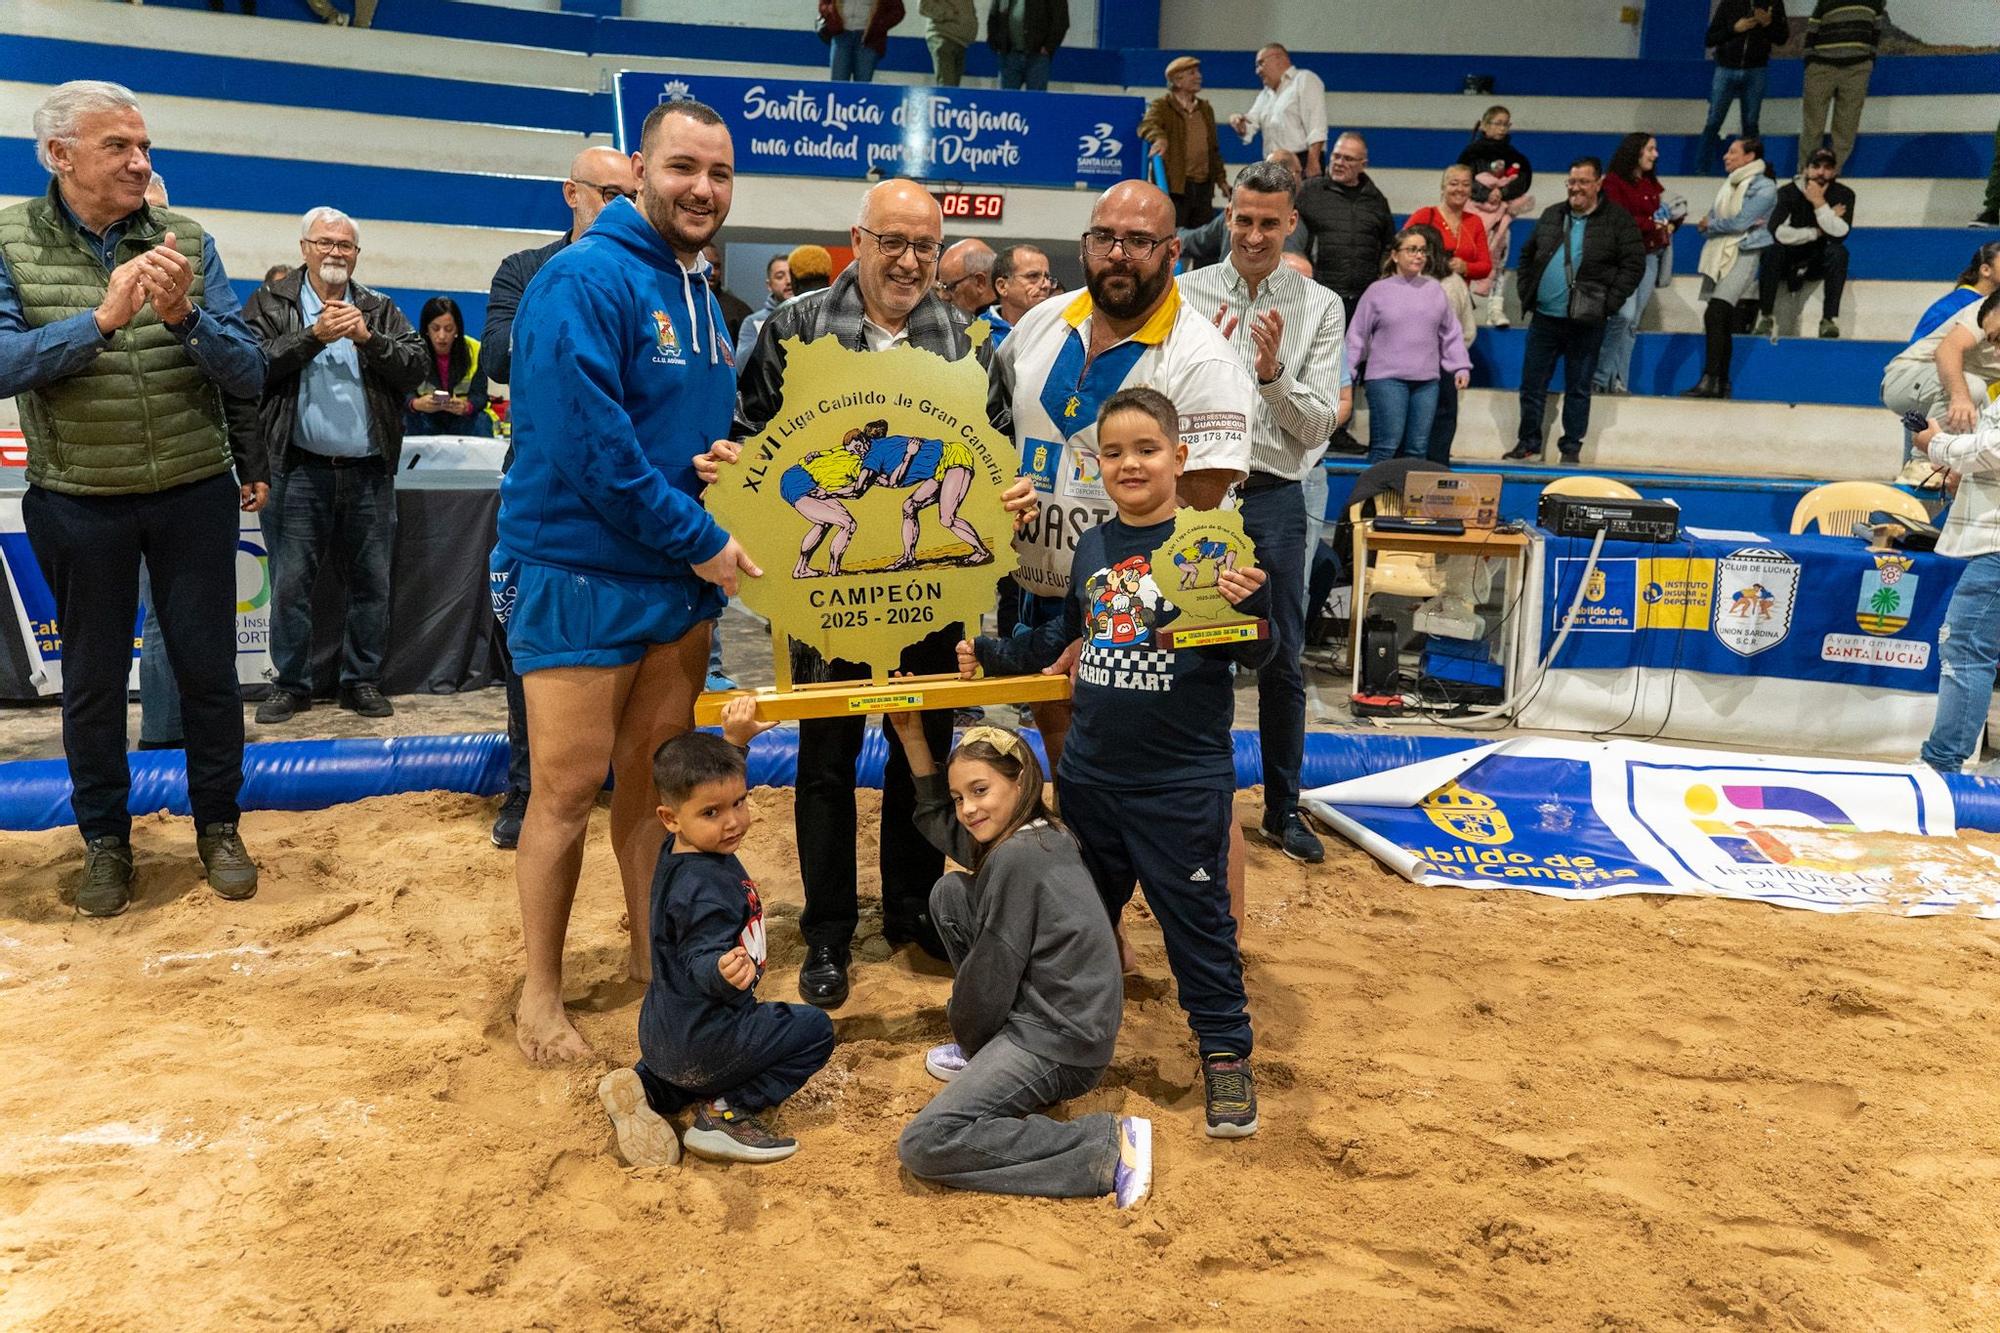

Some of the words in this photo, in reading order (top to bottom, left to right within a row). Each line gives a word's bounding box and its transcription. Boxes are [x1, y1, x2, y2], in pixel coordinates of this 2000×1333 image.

[743, 86, 822, 122] Santa
[822, 93, 885, 131] Lucía
[891, 98, 922, 128] de
[929, 96, 1030, 142] Tirajana,
[751, 138, 791, 157] una
[794, 134, 859, 160] ciudad
[867, 143, 917, 168] para
[939, 135, 1021, 172] Deporte
[1193, 420, 1246, 429] GUAYADEQUE
[743, 436, 782, 493] XLVI
[779, 410, 815, 437] Liga
[818, 391, 886, 414] Cabildo
[894, 393, 912, 408] de
[919, 399, 958, 428] Gran
[960, 425, 1003, 486] Canaria
[1181, 434, 1200, 444] 928
[1203, 432, 1222, 442] 178
[1224, 432, 1242, 441] 744
[1725, 563, 1748, 571] CLUB
[1763, 566, 1791, 575] LUCHA
[1665, 581, 1708, 590] INSTITUTO
[809, 579, 942, 608] CAMPEÓN
[820, 610, 868, 629] 2025
[886, 606, 934, 625] 2026
[1609, 606, 1623, 616] de
[1589, 616, 1629, 625] Canaria
[1720, 627, 1742, 636] UNION
[1744, 629, 1779, 638] SARDINA
[1736, 637, 1758, 646] S.C.R.
[1827, 635, 1927, 652] Ayuntamiento
[1825, 646, 1870, 659] SANTA
[1875, 650, 1923, 665] LUCIA
[1114, 671, 1174, 691] KART
[1543, 854, 1596, 868] de
[1474, 865, 1639, 882] Canaria
[1715, 865, 1851, 886] INSTITUTO
[1745, 880, 1784, 889] DE
